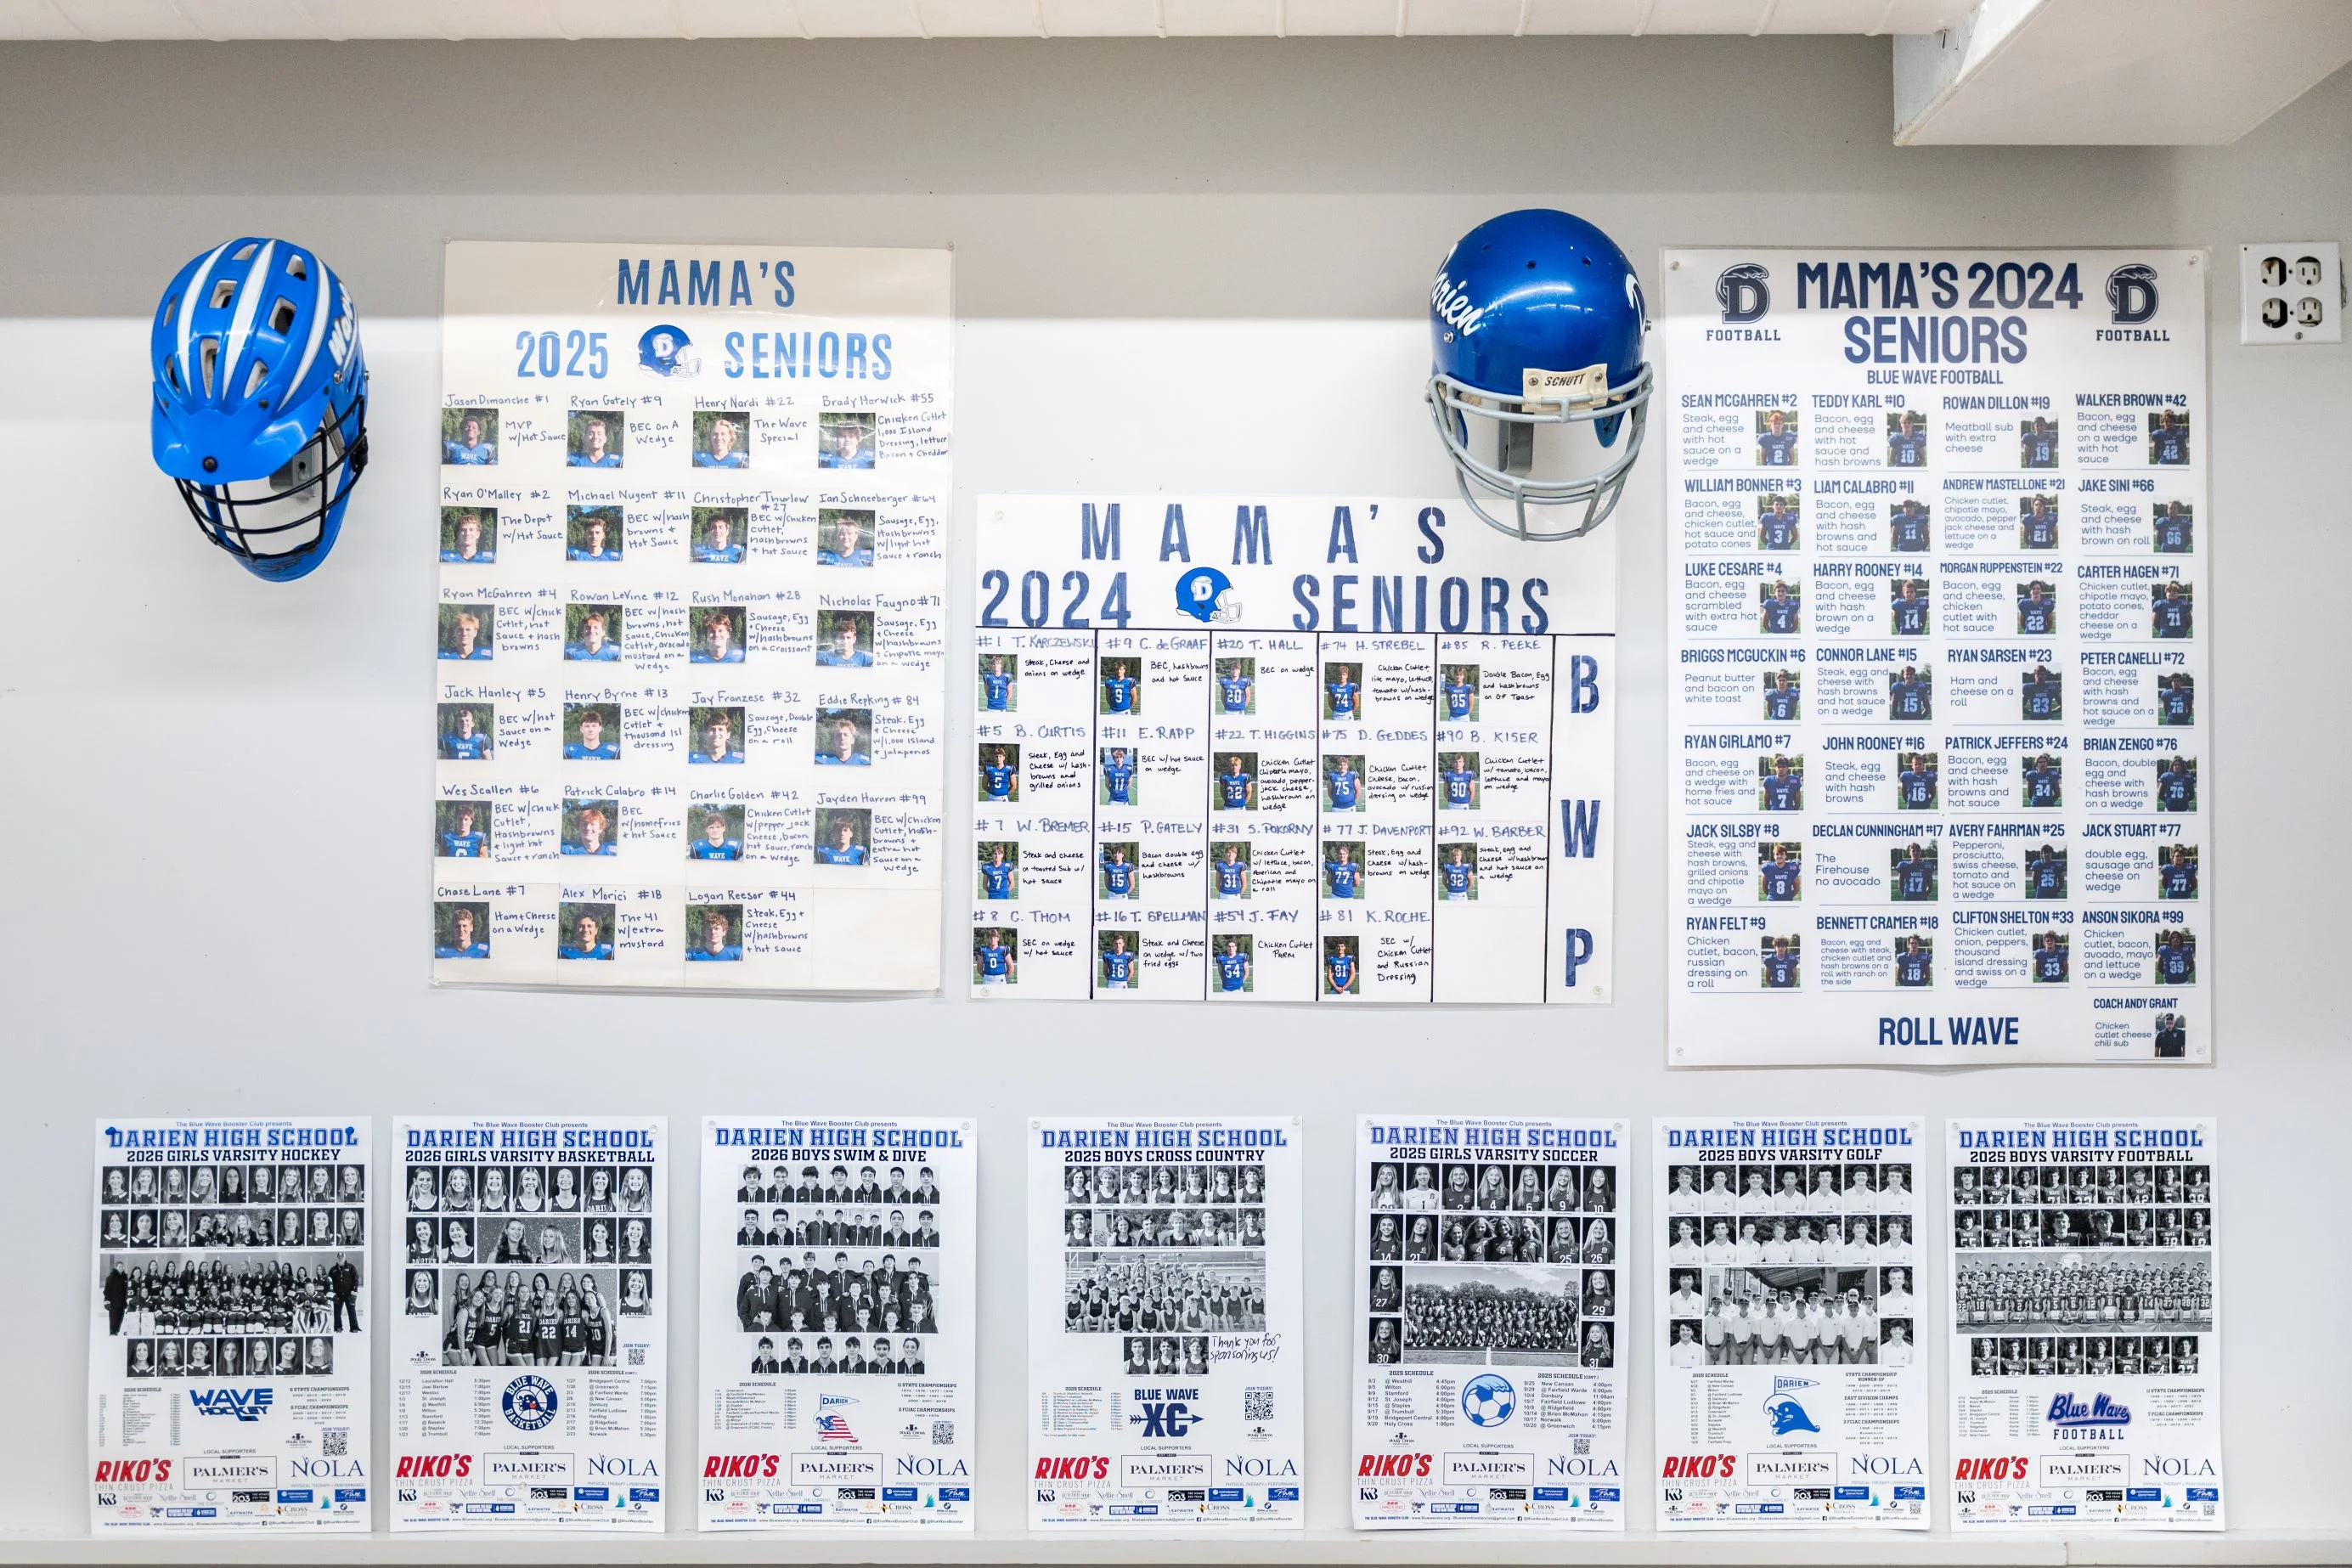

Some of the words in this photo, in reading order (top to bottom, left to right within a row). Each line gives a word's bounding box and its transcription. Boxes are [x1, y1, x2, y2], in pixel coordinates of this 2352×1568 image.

[618, 259, 794, 307] MAMA'S
[1797, 262, 1959, 309] MAMA'S
[1967, 262, 2083, 309] 2024
[1706, 330, 1781, 341] FOOTBALL
[1844, 315, 2028, 364] SENIORS
[2096, 330, 2170, 341] FOOTBALL
[516, 330, 608, 380] 2025
[725, 331, 892, 381] SENIORS
[1544, 374, 1586, 386] SCHUTT
[1867, 369, 1899, 384] BLUE
[1902, 369, 1937, 384] WAVE
[1940, 369, 2004, 385] FOOTBALL
[571, 395, 599, 408] Ryan
[602, 394, 637, 409] Gately
[640, 395, 662, 406] #9
[1681, 394, 1712, 408] SEAN
[1715, 393, 1780, 407] MCGAHREN
[1781, 393, 1797, 407] #2
[1943, 396, 1985, 409] ROWAN
[1988, 396, 2028, 409] DILLON
[2031, 396, 2050, 409] #19
[505, 420, 533, 430] MVP
[1945, 422, 1992, 431] Meatball
[1994, 422, 2014, 431] sub
[1945, 433, 1966, 442] with
[1945, 444, 1983, 453] cheese
[443, 487, 473, 502] Ryan
[477, 488, 522, 501] O'Malley
[530, 490, 550, 499] #2
[500, 516, 522, 526] The
[524, 513, 553, 527] Depot
[1081, 503, 1446, 568] MAMA'S
[982, 569, 1131, 626] 2024
[1290, 574, 1548, 633] SENIORS
[1216, 638, 1244, 650] #20
[1249, 640, 1263, 651] T.
[1268, 640, 1303, 651] HALL
[1948, 649, 1978, 663] RYAN
[1980, 649, 2026, 663] SARSEN
[2028, 649, 2052, 663] #23
[1292, 665, 1314, 677] wedge
[1571, 655, 1599, 713] B
[1950, 676, 1975, 685] Ham
[1977, 676, 1998, 685] and
[444, 685, 474, 699] Jack
[478, 685, 522, 702] Hanley
[527, 687, 545, 698] #5
[1950, 687, 1988, 696] cheese
[1950, 697, 1967, 707] roll
[976, 725, 1002, 737] #5
[1014, 724, 1033, 737] B.
[1038, 725, 1086, 738] CURTIS
[1101, 726, 1125, 739] #11
[1138, 727, 1153, 739] E.
[1155, 726, 1195, 740] RAPP
[1560, 799, 1601, 859] W
[1815, 853, 1836, 863] The
[1815, 865, 1870, 874] Firehouse
[1832, 877, 1881, 886] avocado
[620, 914, 641, 922] The
[645, 912, 657, 922] 41
[1214, 910, 1244, 922] #54
[1249, 910, 1264, 922] J.
[1266, 909, 1299, 922] FAY
[1687, 917, 1717, 930] RYAN
[1720, 917, 1748, 930] FELT
[1750, 917, 1766, 930] #9
[619, 939, 664, 949] mustard
[1565, 928, 1593, 987] P
[2094, 998, 2124, 1009] COACH
[2124, 998, 2147, 1009] ANDY
[2149, 998, 2178, 1008] GRANT
[1879, 1017, 1943, 1046] ROLL
[1948, 1017, 2019, 1046] WAVE
[2095, 1039, 2112, 1047] chili
[109, 1128, 198, 1148] DARIEN
[204, 1129, 261, 1147] HIGH
[267, 1126, 358, 1147] SCHOOL
[407, 1130, 494, 1148] DARIEN
[500, 1130, 557, 1148] HIGH
[563, 1130, 653, 1148] SCHOOL
[715, 1128, 804, 1147] DARIEN
[810, 1128, 866, 1147] HIGH
[872, 1130, 962, 1148] SCHOOL
[1041, 1130, 1129, 1148] DARIEN
[1136, 1130, 1192, 1148] HIGH
[1198, 1129, 1287, 1148] SCHOOL
[1370, 1126, 1459, 1149] DARIEN
[1464, 1128, 1521, 1149] HIGH
[1527, 1129, 1616, 1148] SCHOOL
[1668, 1129, 1756, 1148] DARIEN
[1762, 1129, 1817, 1147] HIGH
[1824, 1128, 1912, 1146] SCHOOL
[1960, 1131, 2046, 1148] DARIEN
[2052, 1130, 2108, 1148] HIGH
[2114, 1130, 2203, 1148] SCHOOL
[127, 1150, 163, 1162] 2026
[167, 1150, 209, 1162] GIRLS
[212, 1149, 278, 1161] VARSITY
[281, 1148, 341, 1161] HOCKEY
[752, 1148, 788, 1160] 2026
[792, 1149, 830, 1161] BOYS
[833, 1149, 875, 1161] SWIM
[879, 1150, 888, 1162] &
[893, 1150, 926, 1162] DIVE
[1390, 1148, 1426, 1159] 2025
[1430, 1148, 1471, 1160] GIRLS
[1475, 1148, 1539, 1161] VARSITY
[1543, 1150, 1598, 1162] SOCCER
[1971, 1151, 2005, 1163] 2025
[2010, 1151, 2047, 1162] BOYS
[2050, 1150, 2115, 1162] VARSITY
[2118, 1150, 2193, 1162] FOOTBALL
[1212, 1336, 1241, 1349] Thank
[1244, 1339, 1260, 1349] you
[1210, 1348, 1258, 1363] sponsoring
[1260, 1346, 1279, 1362] us!
[189, 1388, 273, 1406] WAVE
[1134, 1389, 1161, 1401] BLUE
[1165, 1389, 1199, 1400] WAVE
[2048, 1394, 2088, 1420] Blue
[2093, 1394, 2129, 1418] Wave
[1142, 1402, 1187, 1437] XC
[2053, 1429, 2124, 1440] FOOTBALL
[95, 1458, 172, 1482] RIKO'S
[493, 1463, 566, 1472] PALMER'S
[588, 1454, 658, 1476] NOLA
[703, 1453, 780, 1478] RIKO'S
[1035, 1455, 1109, 1480] RIKO'S
[1452, 1463, 1526, 1472] PALMER'S
[1548, 1452, 1619, 1476] NOLA
[1955, 1456, 2028, 1480] RIKO'S
[2143, 1455, 2215, 1475] NOLA
[511, 1475, 545, 1484] MARKET
